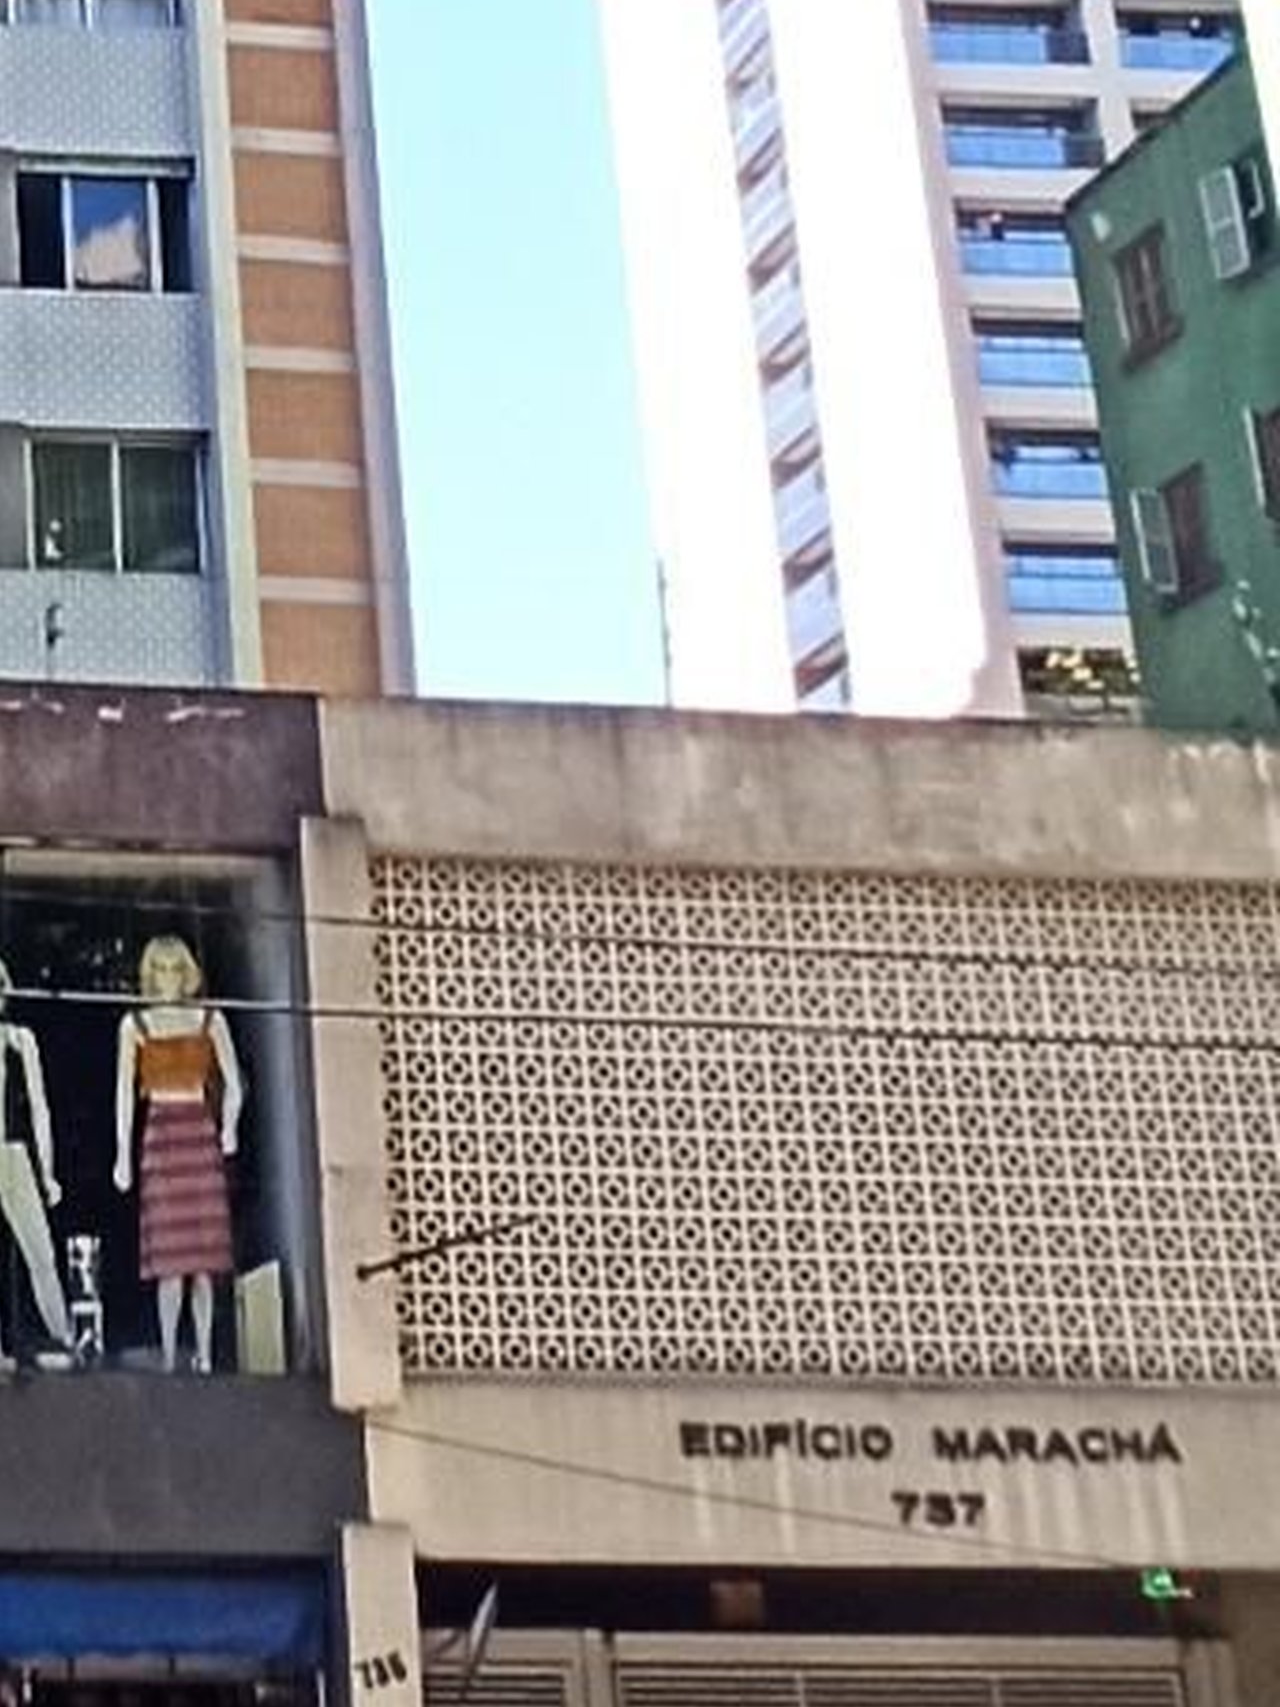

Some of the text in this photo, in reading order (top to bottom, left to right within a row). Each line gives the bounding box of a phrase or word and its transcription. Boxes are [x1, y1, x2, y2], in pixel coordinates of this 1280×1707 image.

[679, 1419, 1182, 1465] EDIFÍCIO MARACHÁ
[891, 1491, 985, 1527] 737
